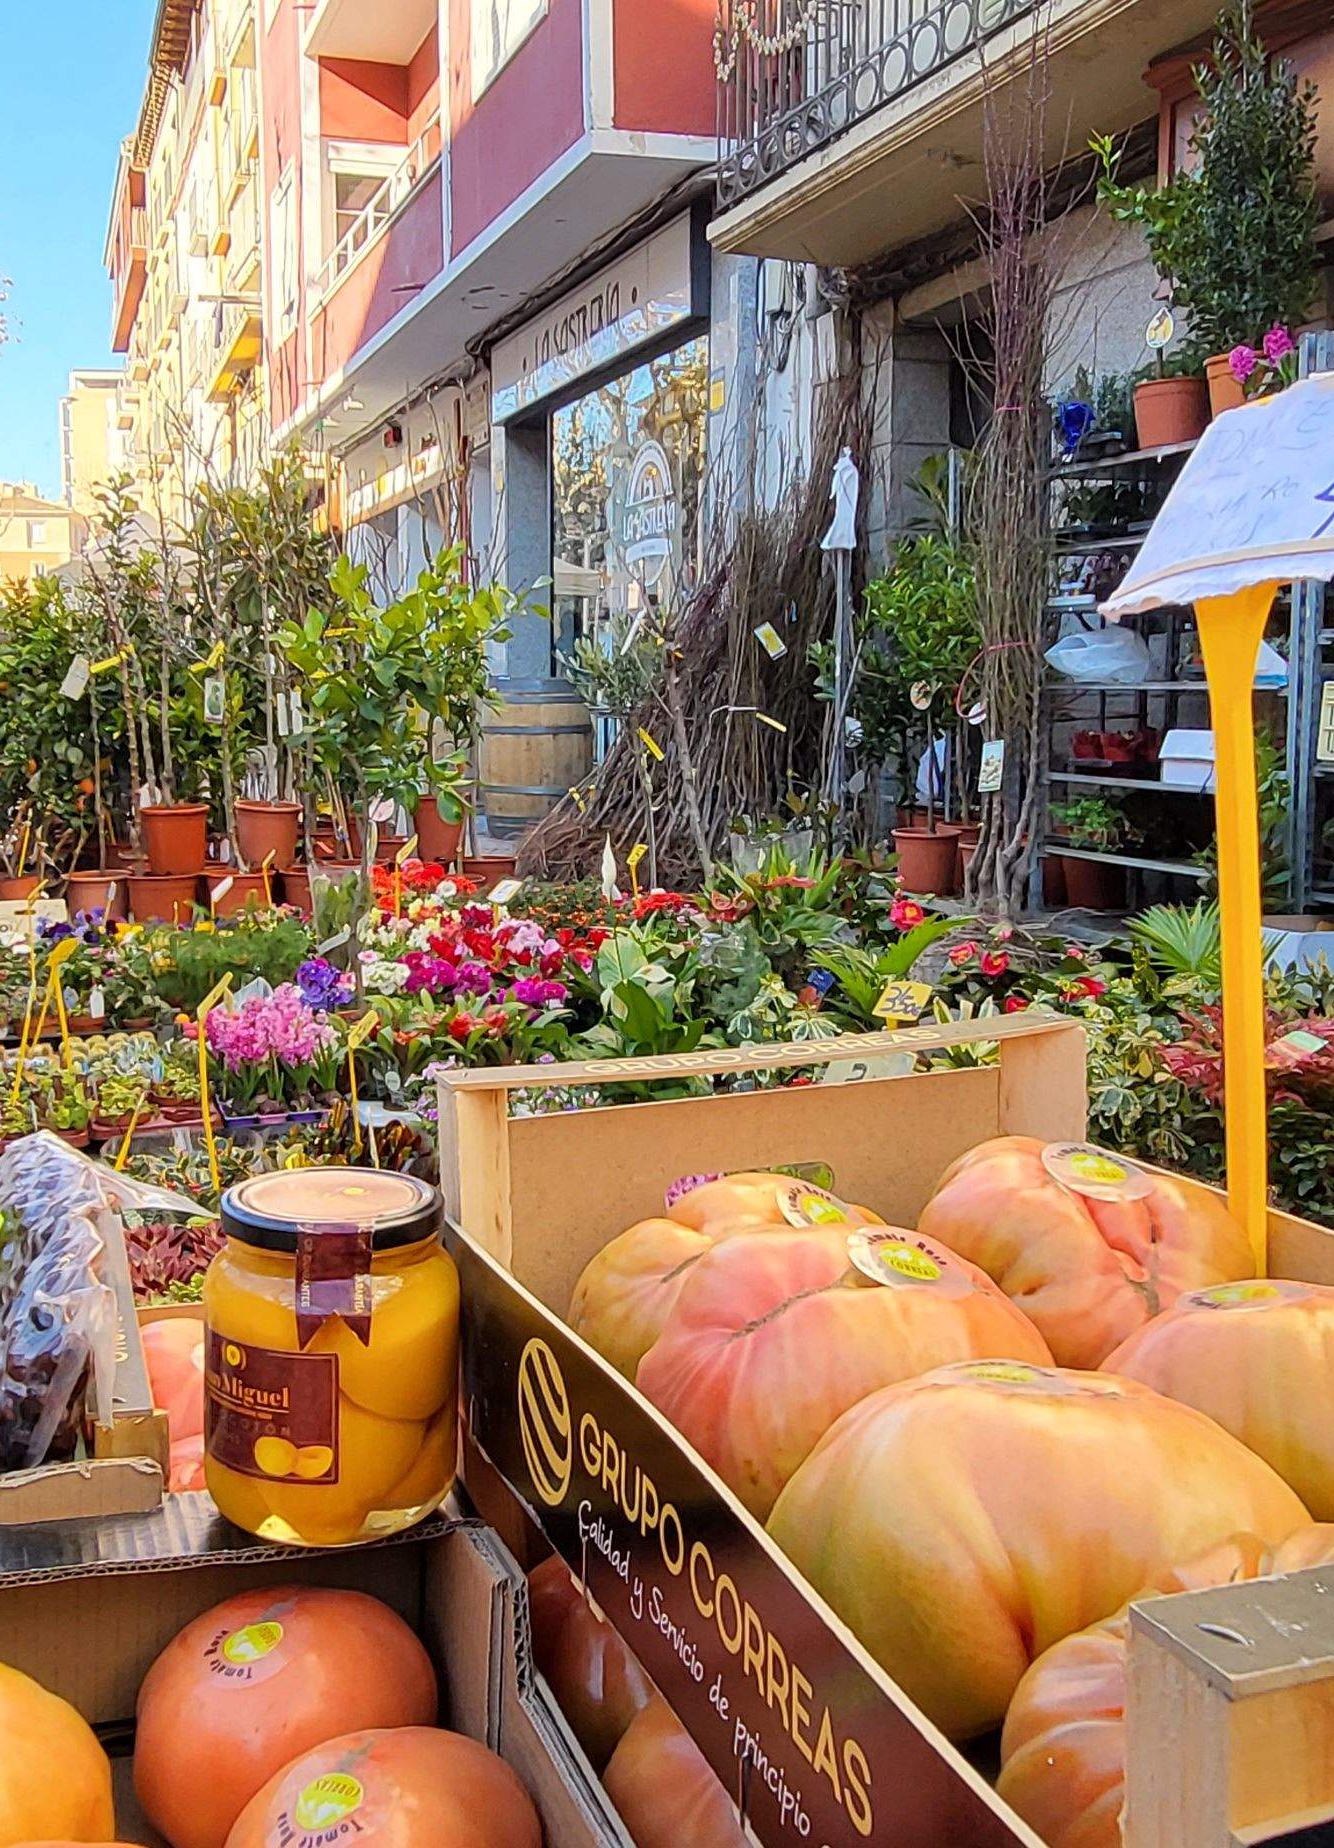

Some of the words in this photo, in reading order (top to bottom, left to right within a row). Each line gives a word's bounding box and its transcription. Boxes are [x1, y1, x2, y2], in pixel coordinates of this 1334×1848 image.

[584, 1052, 742, 1075] GRUPO
[747, 1028, 941, 1062] CORREAS
[577, 1500, 630, 1585] Calidad
[630, 1576, 644, 1620] y
[647, 1583, 704, 1683] Servicio
[709, 1674, 730, 1722] de
[733, 1717, 811, 1837] principio
[579, 1412, 684, 1576] GRUPO
[689, 1540, 873, 1836] CORREAS
